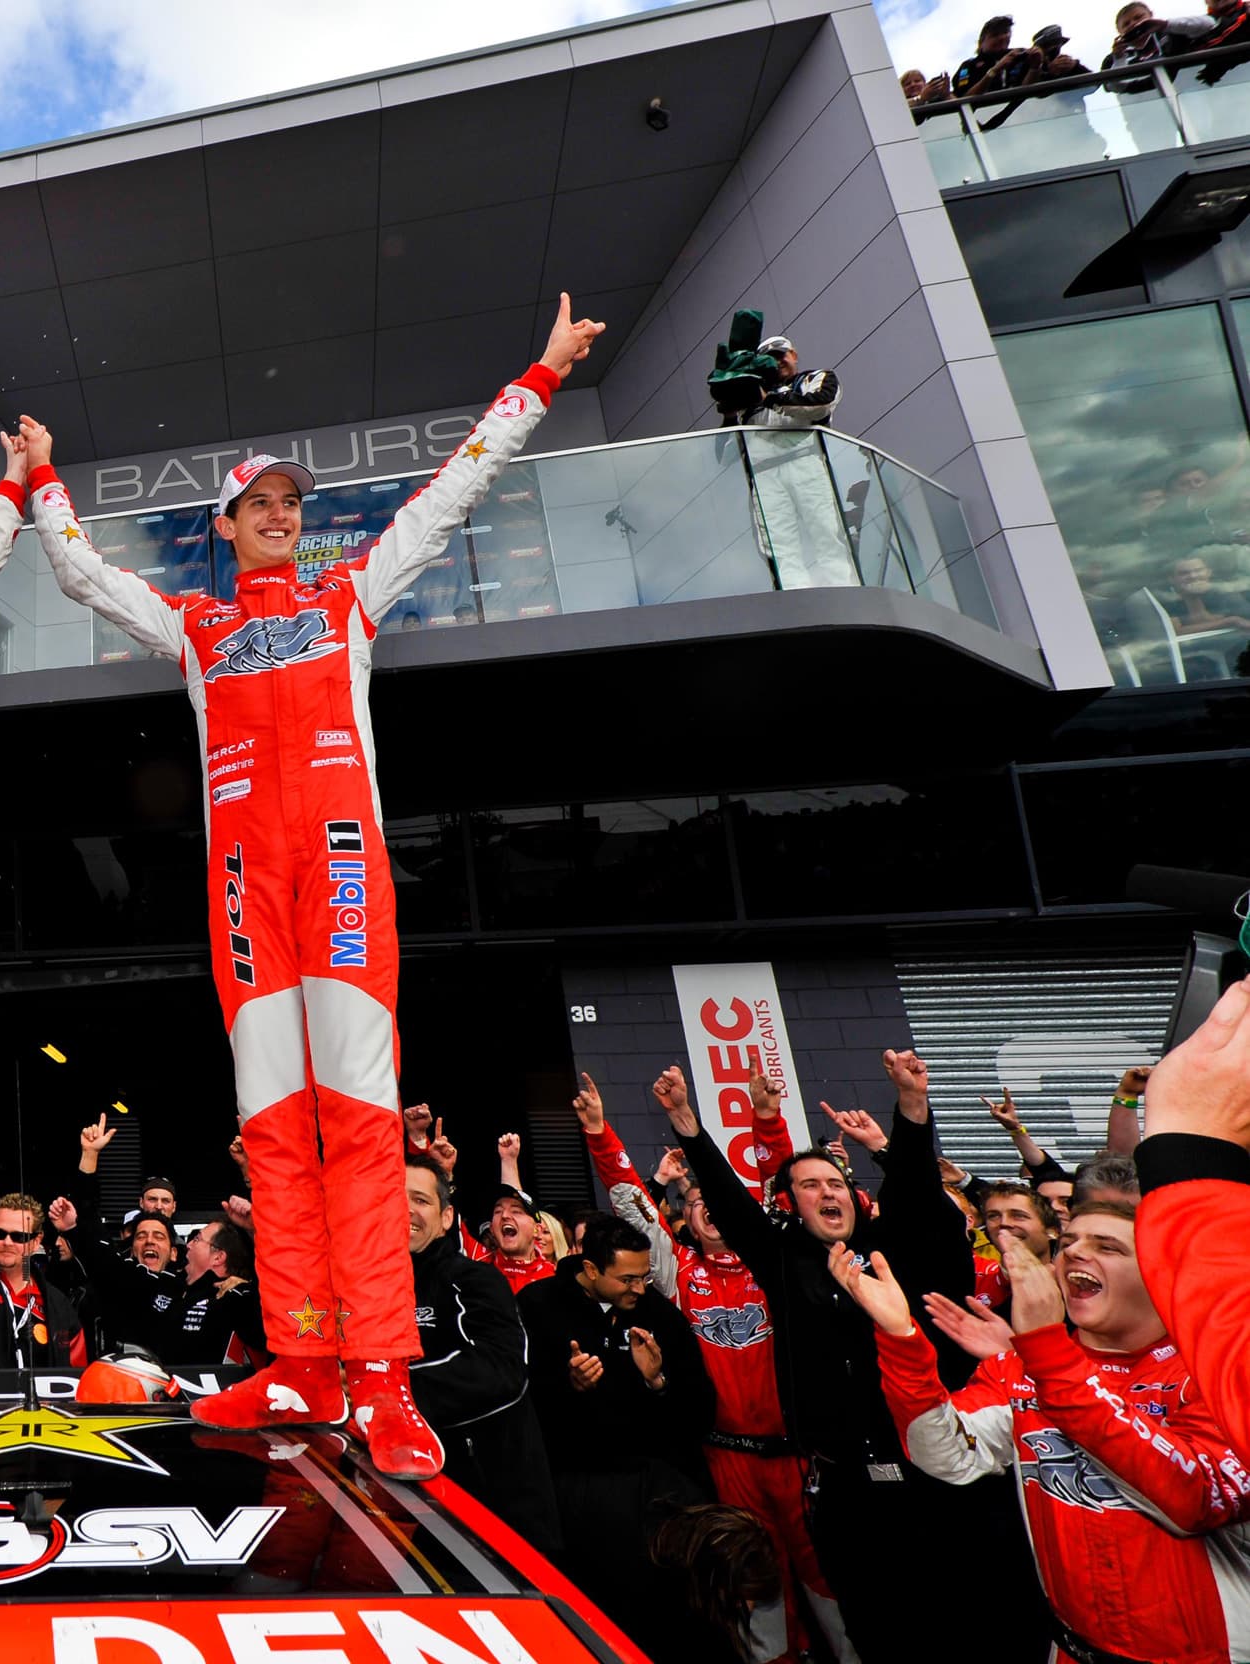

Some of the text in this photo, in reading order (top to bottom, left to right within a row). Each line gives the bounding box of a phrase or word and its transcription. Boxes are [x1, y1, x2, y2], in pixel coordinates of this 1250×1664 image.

[327, 826, 367, 967] Mobil 1
[570, 1006, 597, 1023] 36
[700, 996, 764, 1190] OPEC
[1086, 1375, 1197, 1476] HOLDEN
